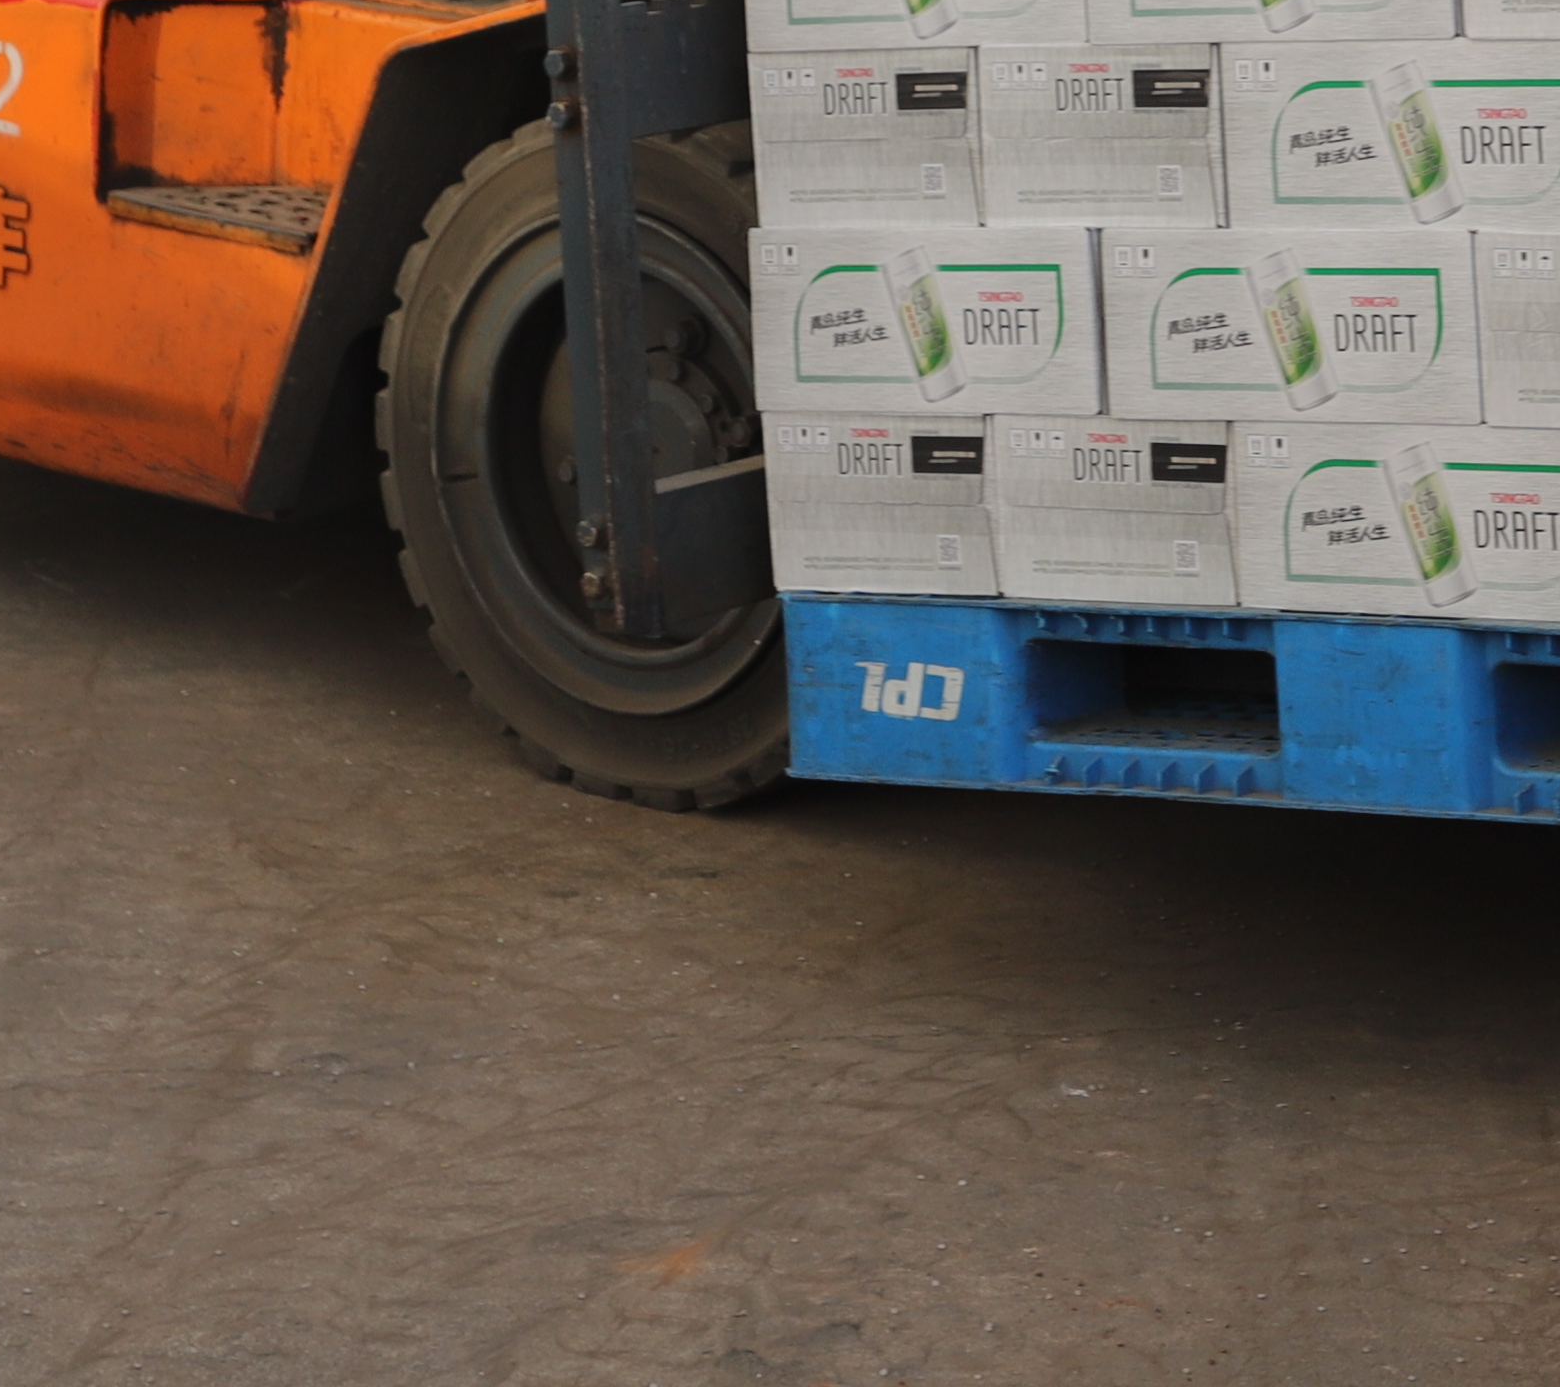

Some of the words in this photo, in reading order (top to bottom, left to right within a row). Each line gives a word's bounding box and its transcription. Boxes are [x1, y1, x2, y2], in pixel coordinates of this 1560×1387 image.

[836, 67, 875, 79] TSINGTAO
[1069, 62, 1110, 74] TSINGTAO
[824, 82, 887, 115] DRAFT
[1056, 78, 1124, 111] DRAFT
[1478, 107, 1528, 120] TSINGTAO
[1460, 126, 1546, 164] DRAFT
[978, 291, 1023, 303] TSINGTAO
[1351, 296, 1399, 308] TSINGTAO
[964, 308, 1040, 345] DRAFT
[1334, 314, 1417, 352] DRAFT
[851, 427, 890, 439] TSINGTAO
[1087, 432, 1129, 445] TSINGTAO
[838, 443, 903, 475] DRAFT
[1074, 448, 1142, 482] DRAFT
[1491, 492, 1542, 505] TSINGTAO
[1474, 510, 1560, 550] DRAFT
